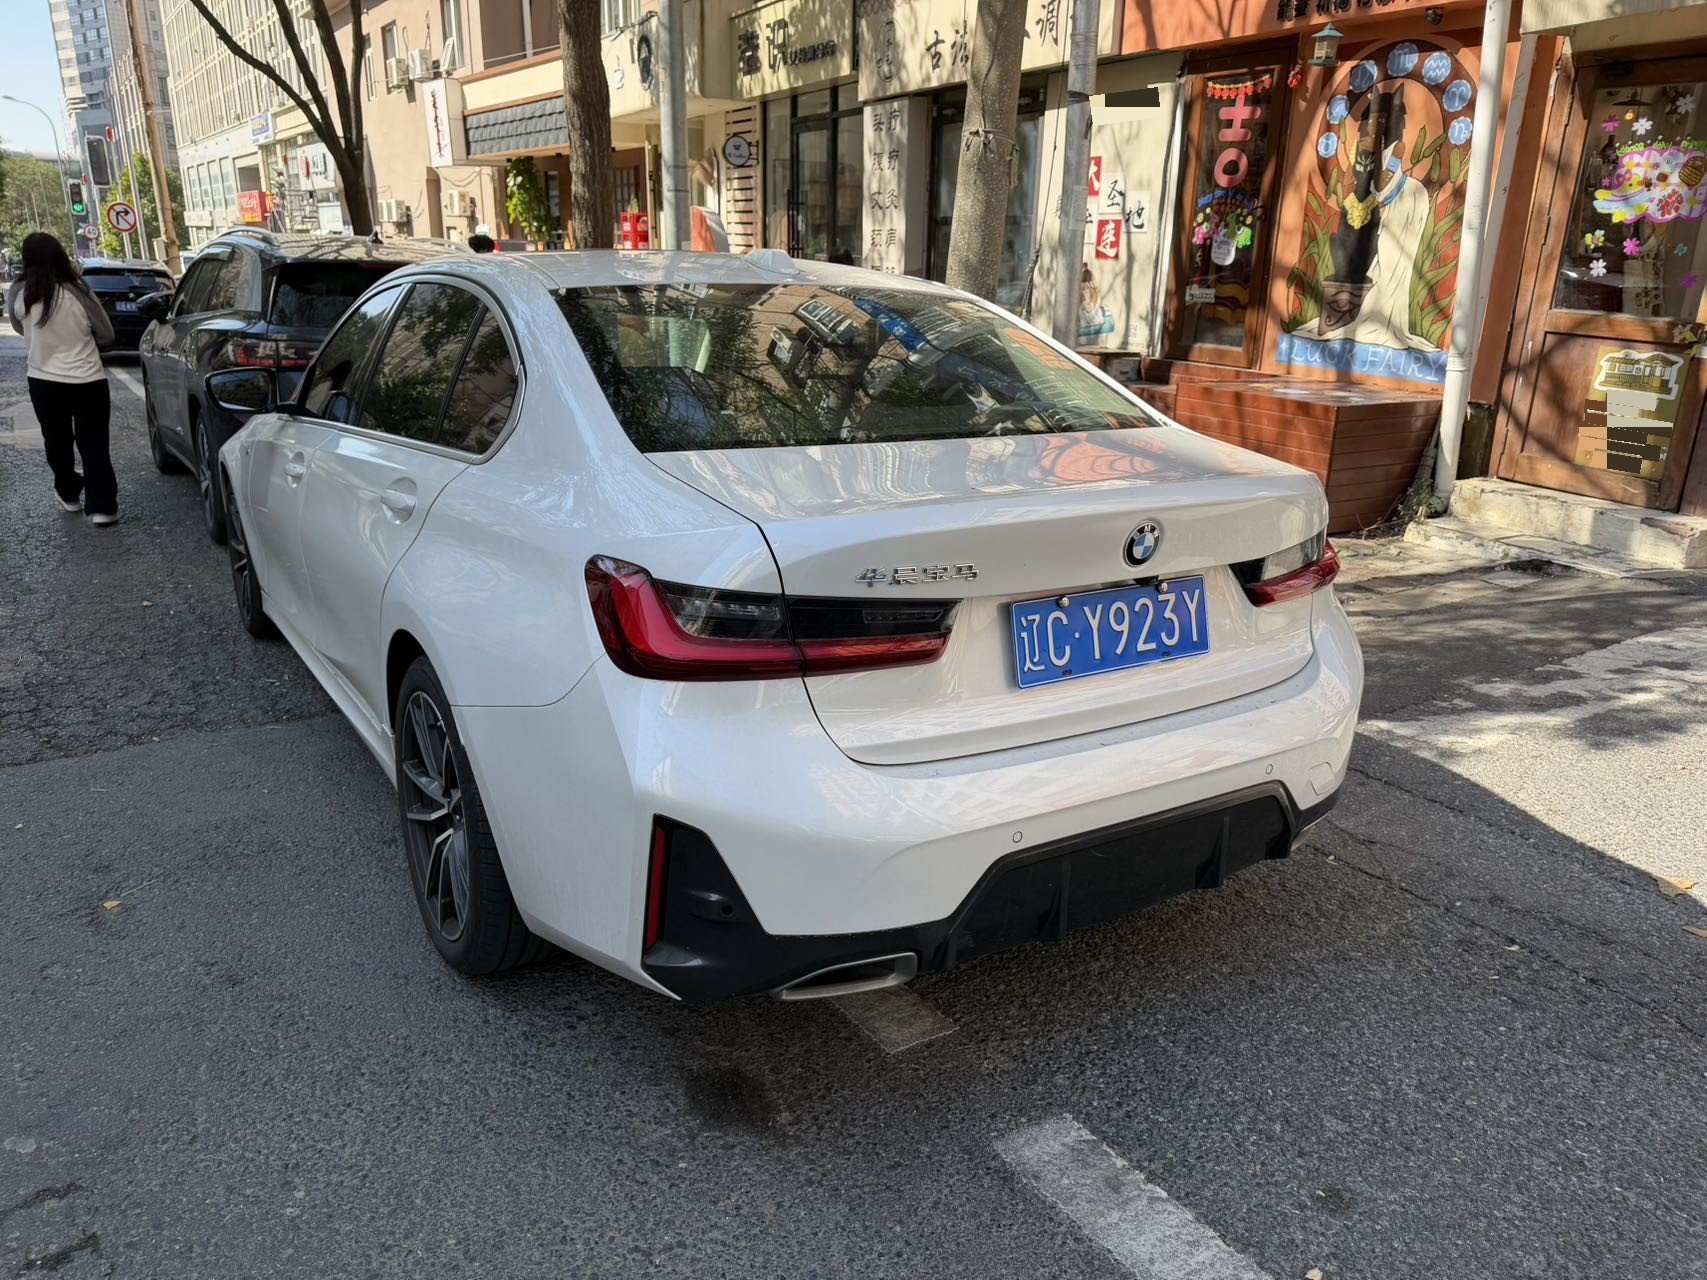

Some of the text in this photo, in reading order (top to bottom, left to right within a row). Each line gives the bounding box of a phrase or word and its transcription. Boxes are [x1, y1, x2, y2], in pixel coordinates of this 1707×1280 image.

[872, 109, 901, 132] 头疗
[871, 189, 898, 210] 艾灸
[1291, 341, 1448, 381] LUCK FAIRY
[855, 563, 979, 587] 华晨宝马
[1020, 588, 1201, 672] 辽C·Y923Y
